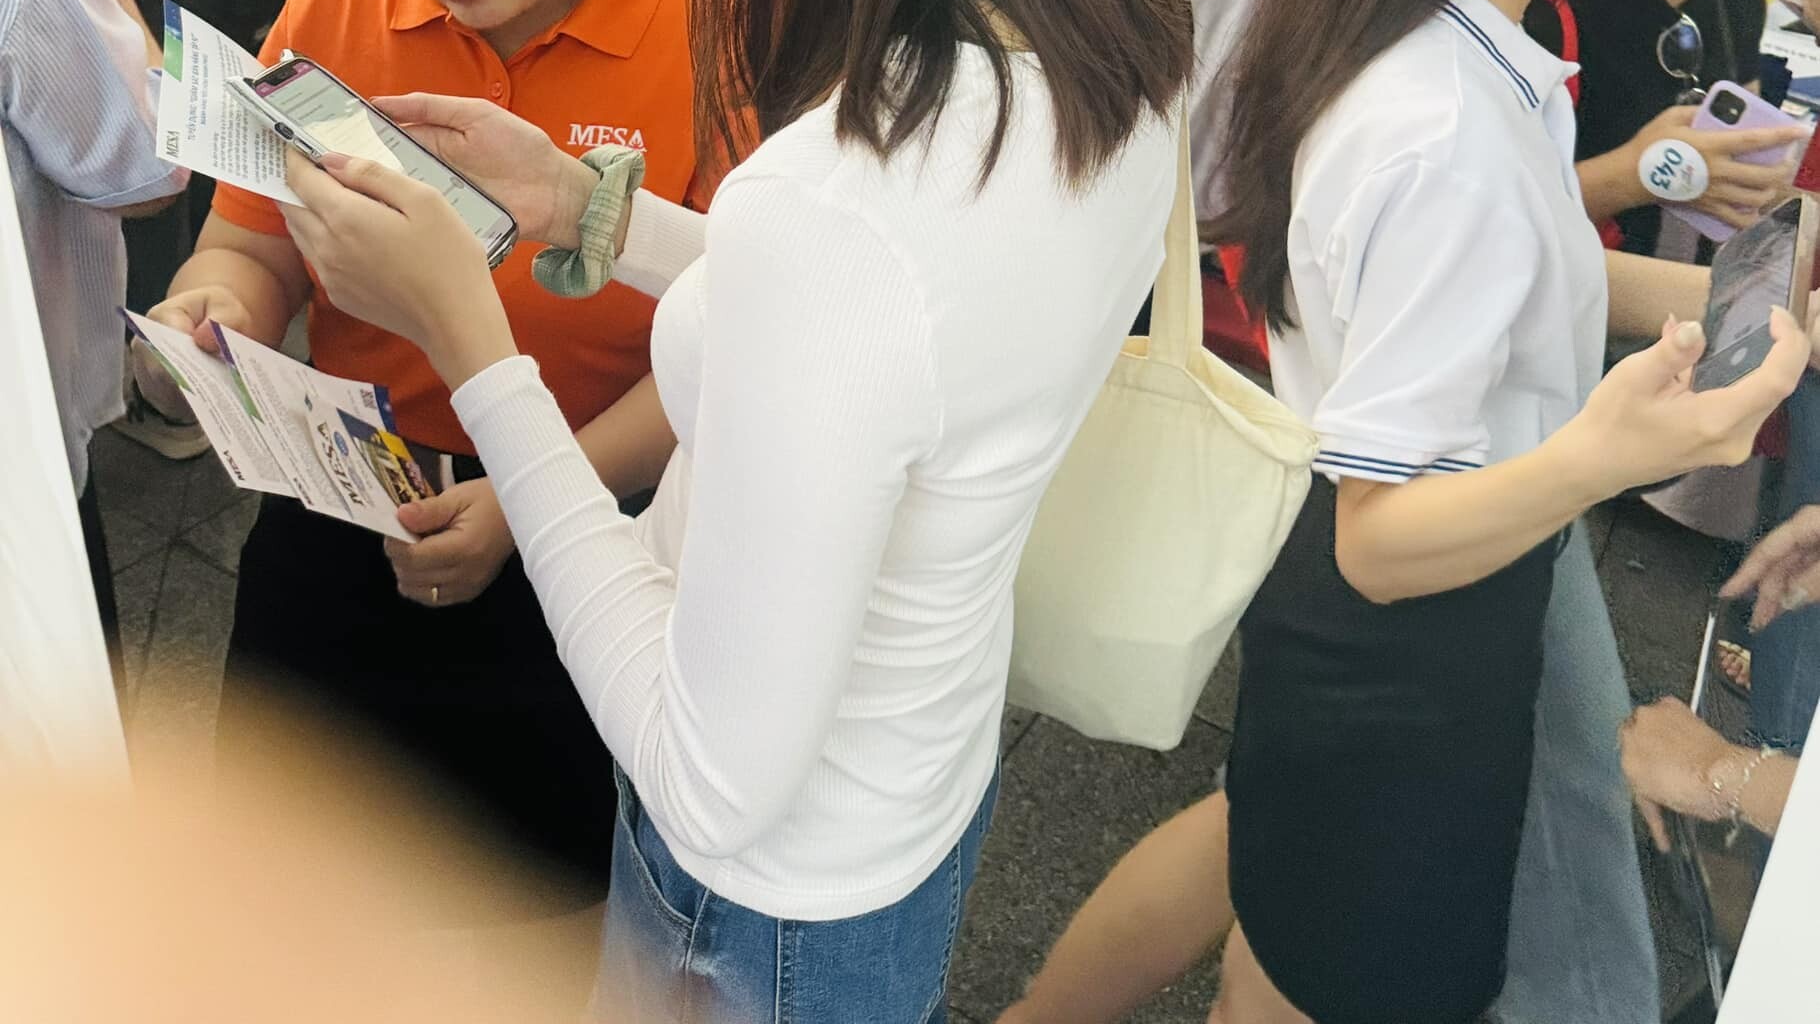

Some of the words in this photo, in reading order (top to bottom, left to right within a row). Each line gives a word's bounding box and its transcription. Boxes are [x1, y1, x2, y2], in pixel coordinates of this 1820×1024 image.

[166, 130, 181, 159] MESA
[567, 123, 648, 153] MESA
[1650, 148, 1683, 190] 043
[317, 422, 364, 507] MESA
